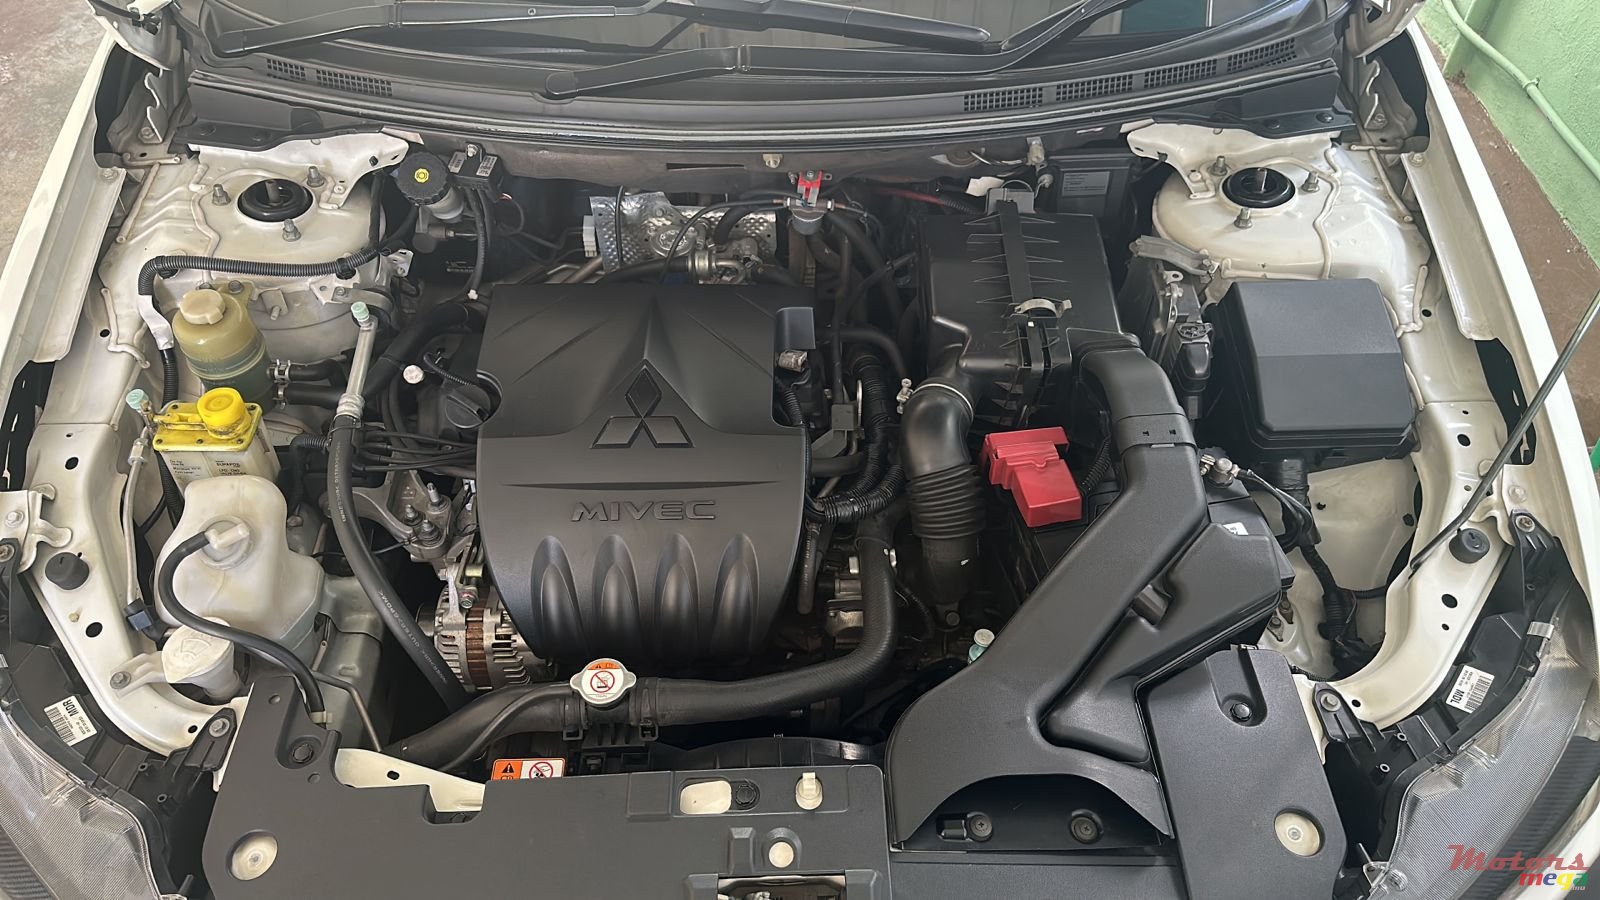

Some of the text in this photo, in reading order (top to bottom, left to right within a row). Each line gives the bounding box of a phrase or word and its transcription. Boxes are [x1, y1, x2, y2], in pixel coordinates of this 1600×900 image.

[571, 501, 716, 521] MIVEC
[1450, 689, 1465, 704] MDL
[62, 699, 79, 717] MDR
